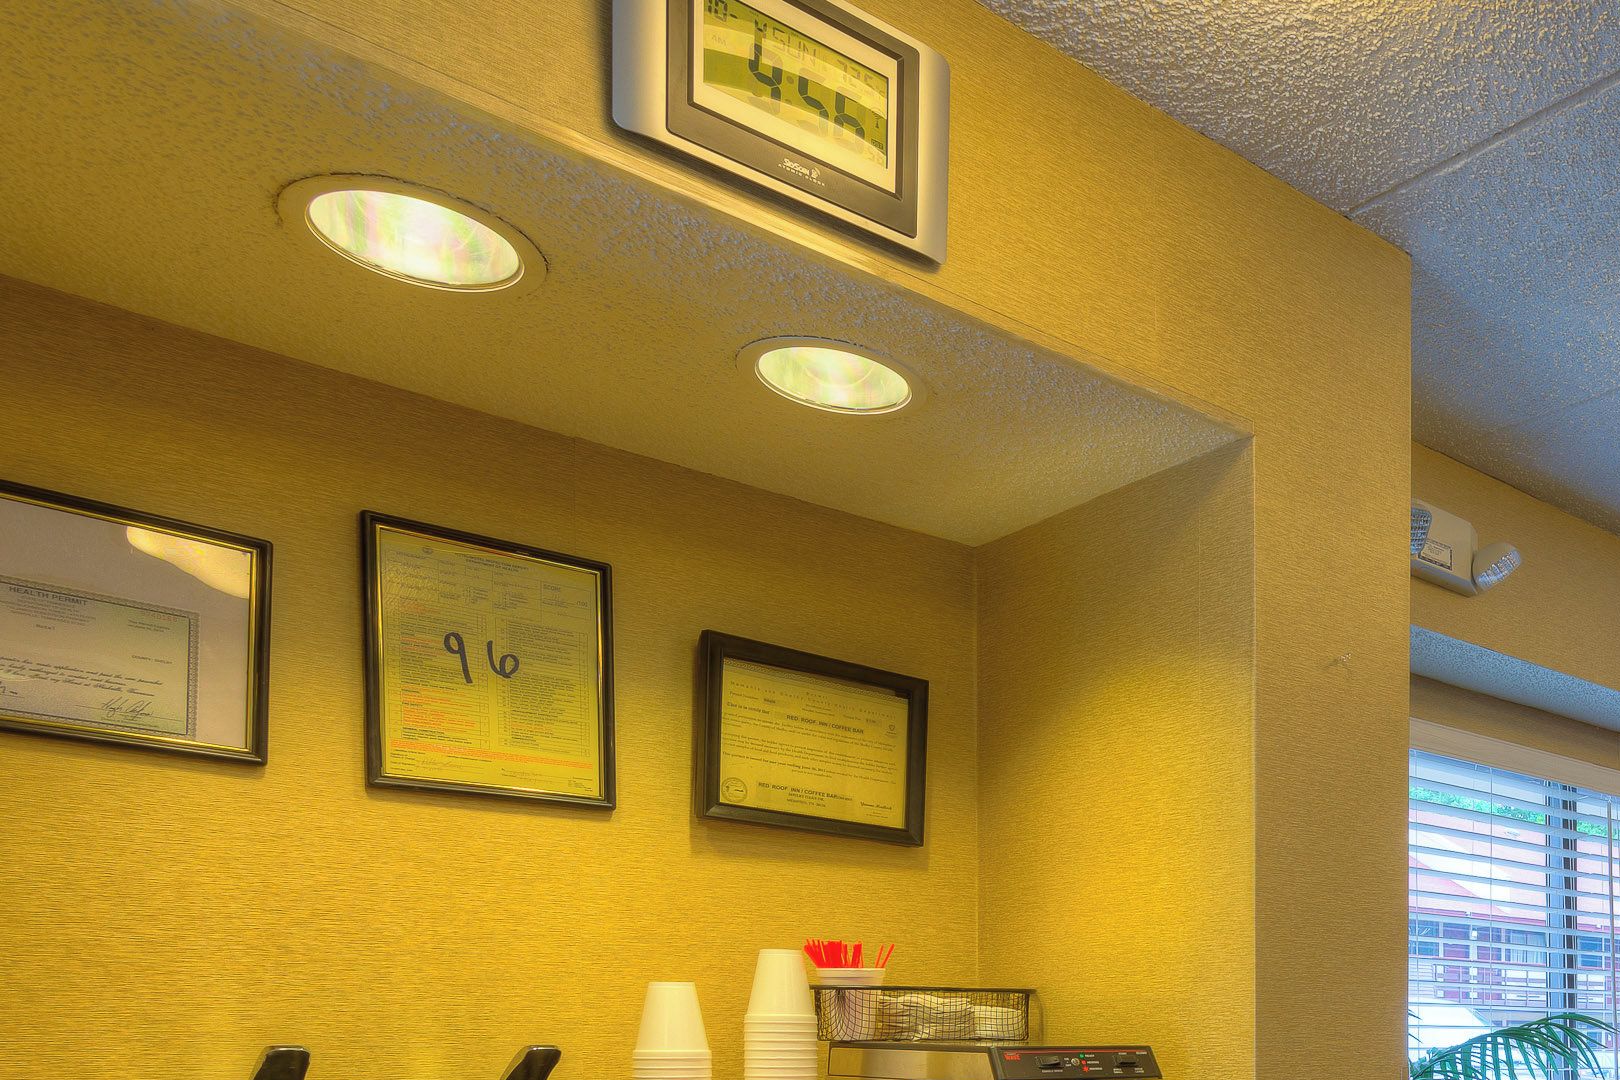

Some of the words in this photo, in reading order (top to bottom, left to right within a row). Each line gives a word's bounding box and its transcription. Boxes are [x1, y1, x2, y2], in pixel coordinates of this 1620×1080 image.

[9, 585, 49, 599] HEALTH
[52, 593, 88, 606] PERMIT
[443, 631, 520, 684] 96
[800, 717, 817, 725] ROOF
[832, 723, 852, 733] COFFEE
[804, 789, 826, 798] COFFEE
